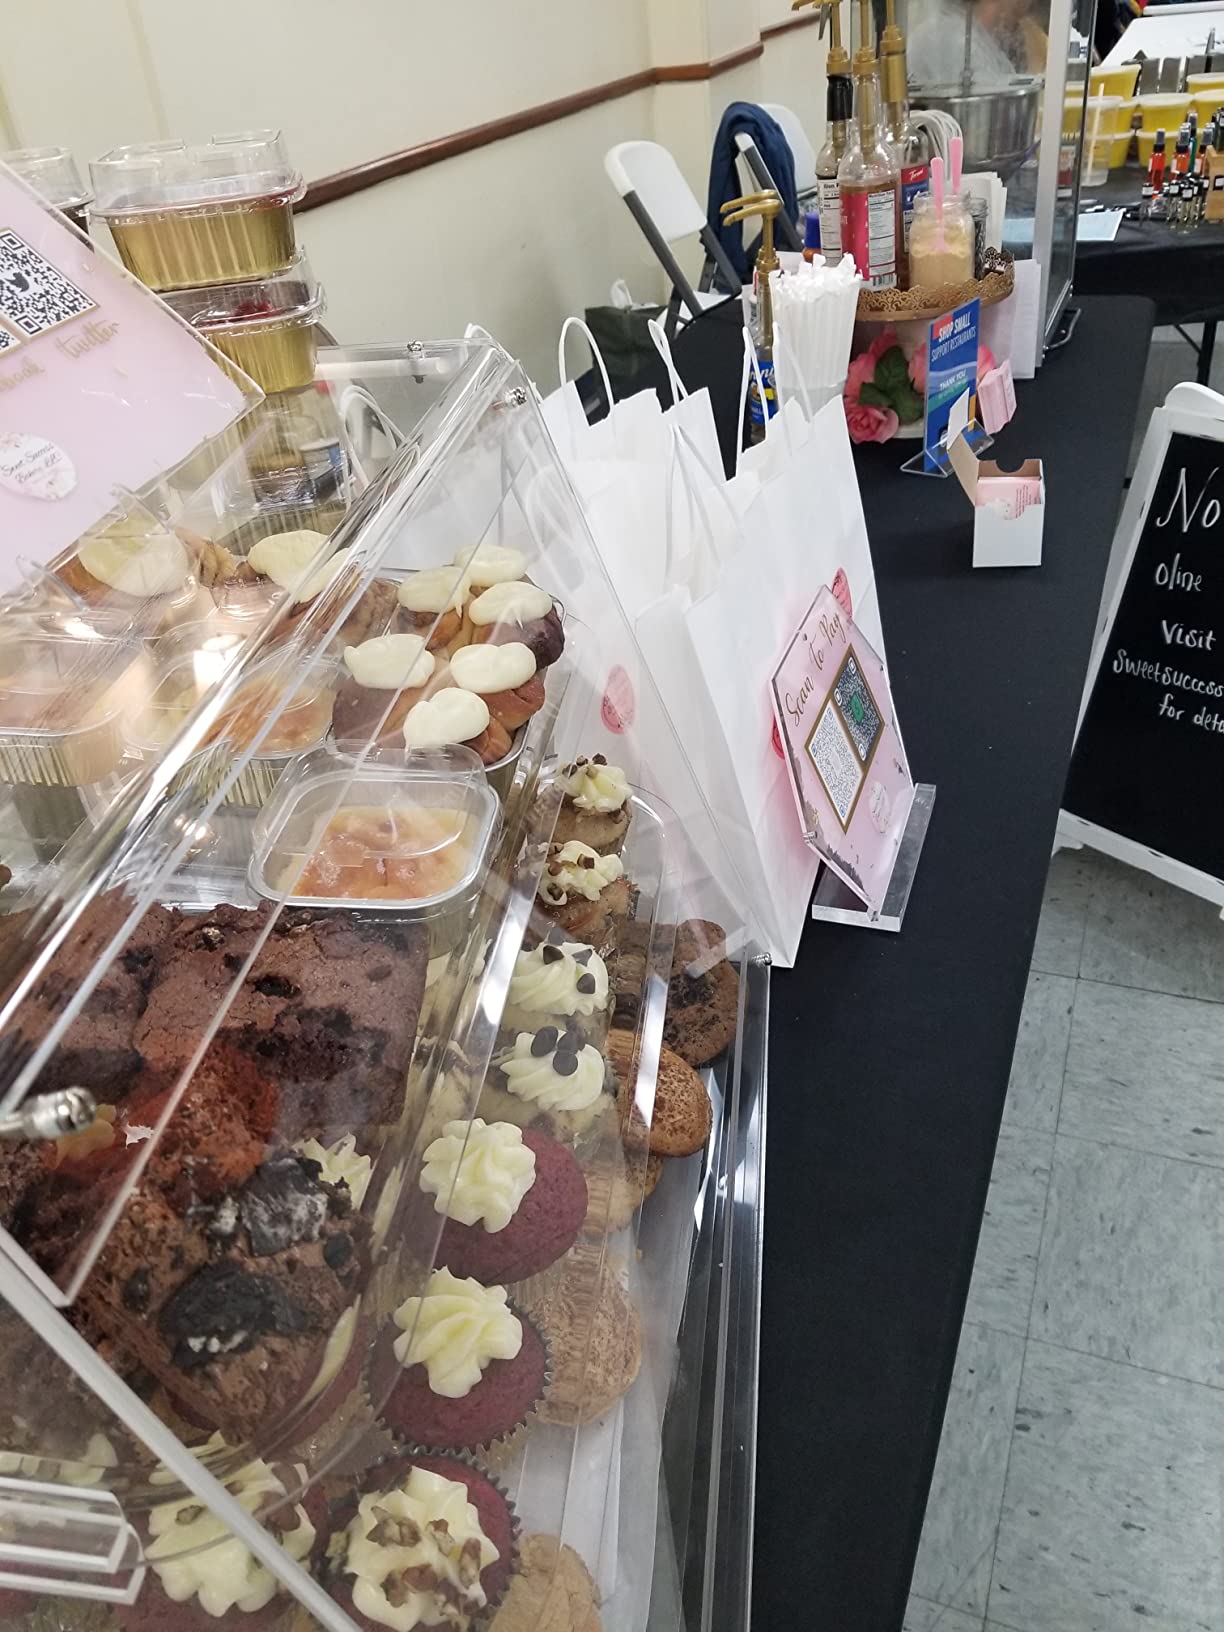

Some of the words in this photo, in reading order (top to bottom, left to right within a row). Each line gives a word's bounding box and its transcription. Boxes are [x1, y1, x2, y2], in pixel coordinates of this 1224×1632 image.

[939, 321, 954, 342] SHOP
[954, 311, 971, 334] SMALL
[931, 340, 951, 362] SUPPORT
[950, 325, 977, 351] RESTAURANTS
[1162, 619, 1217, 651] Visit
[785, 675, 815, 727] Scan
[819, 612, 847, 648] Pay
[1159, 693, 1185, 721] for
